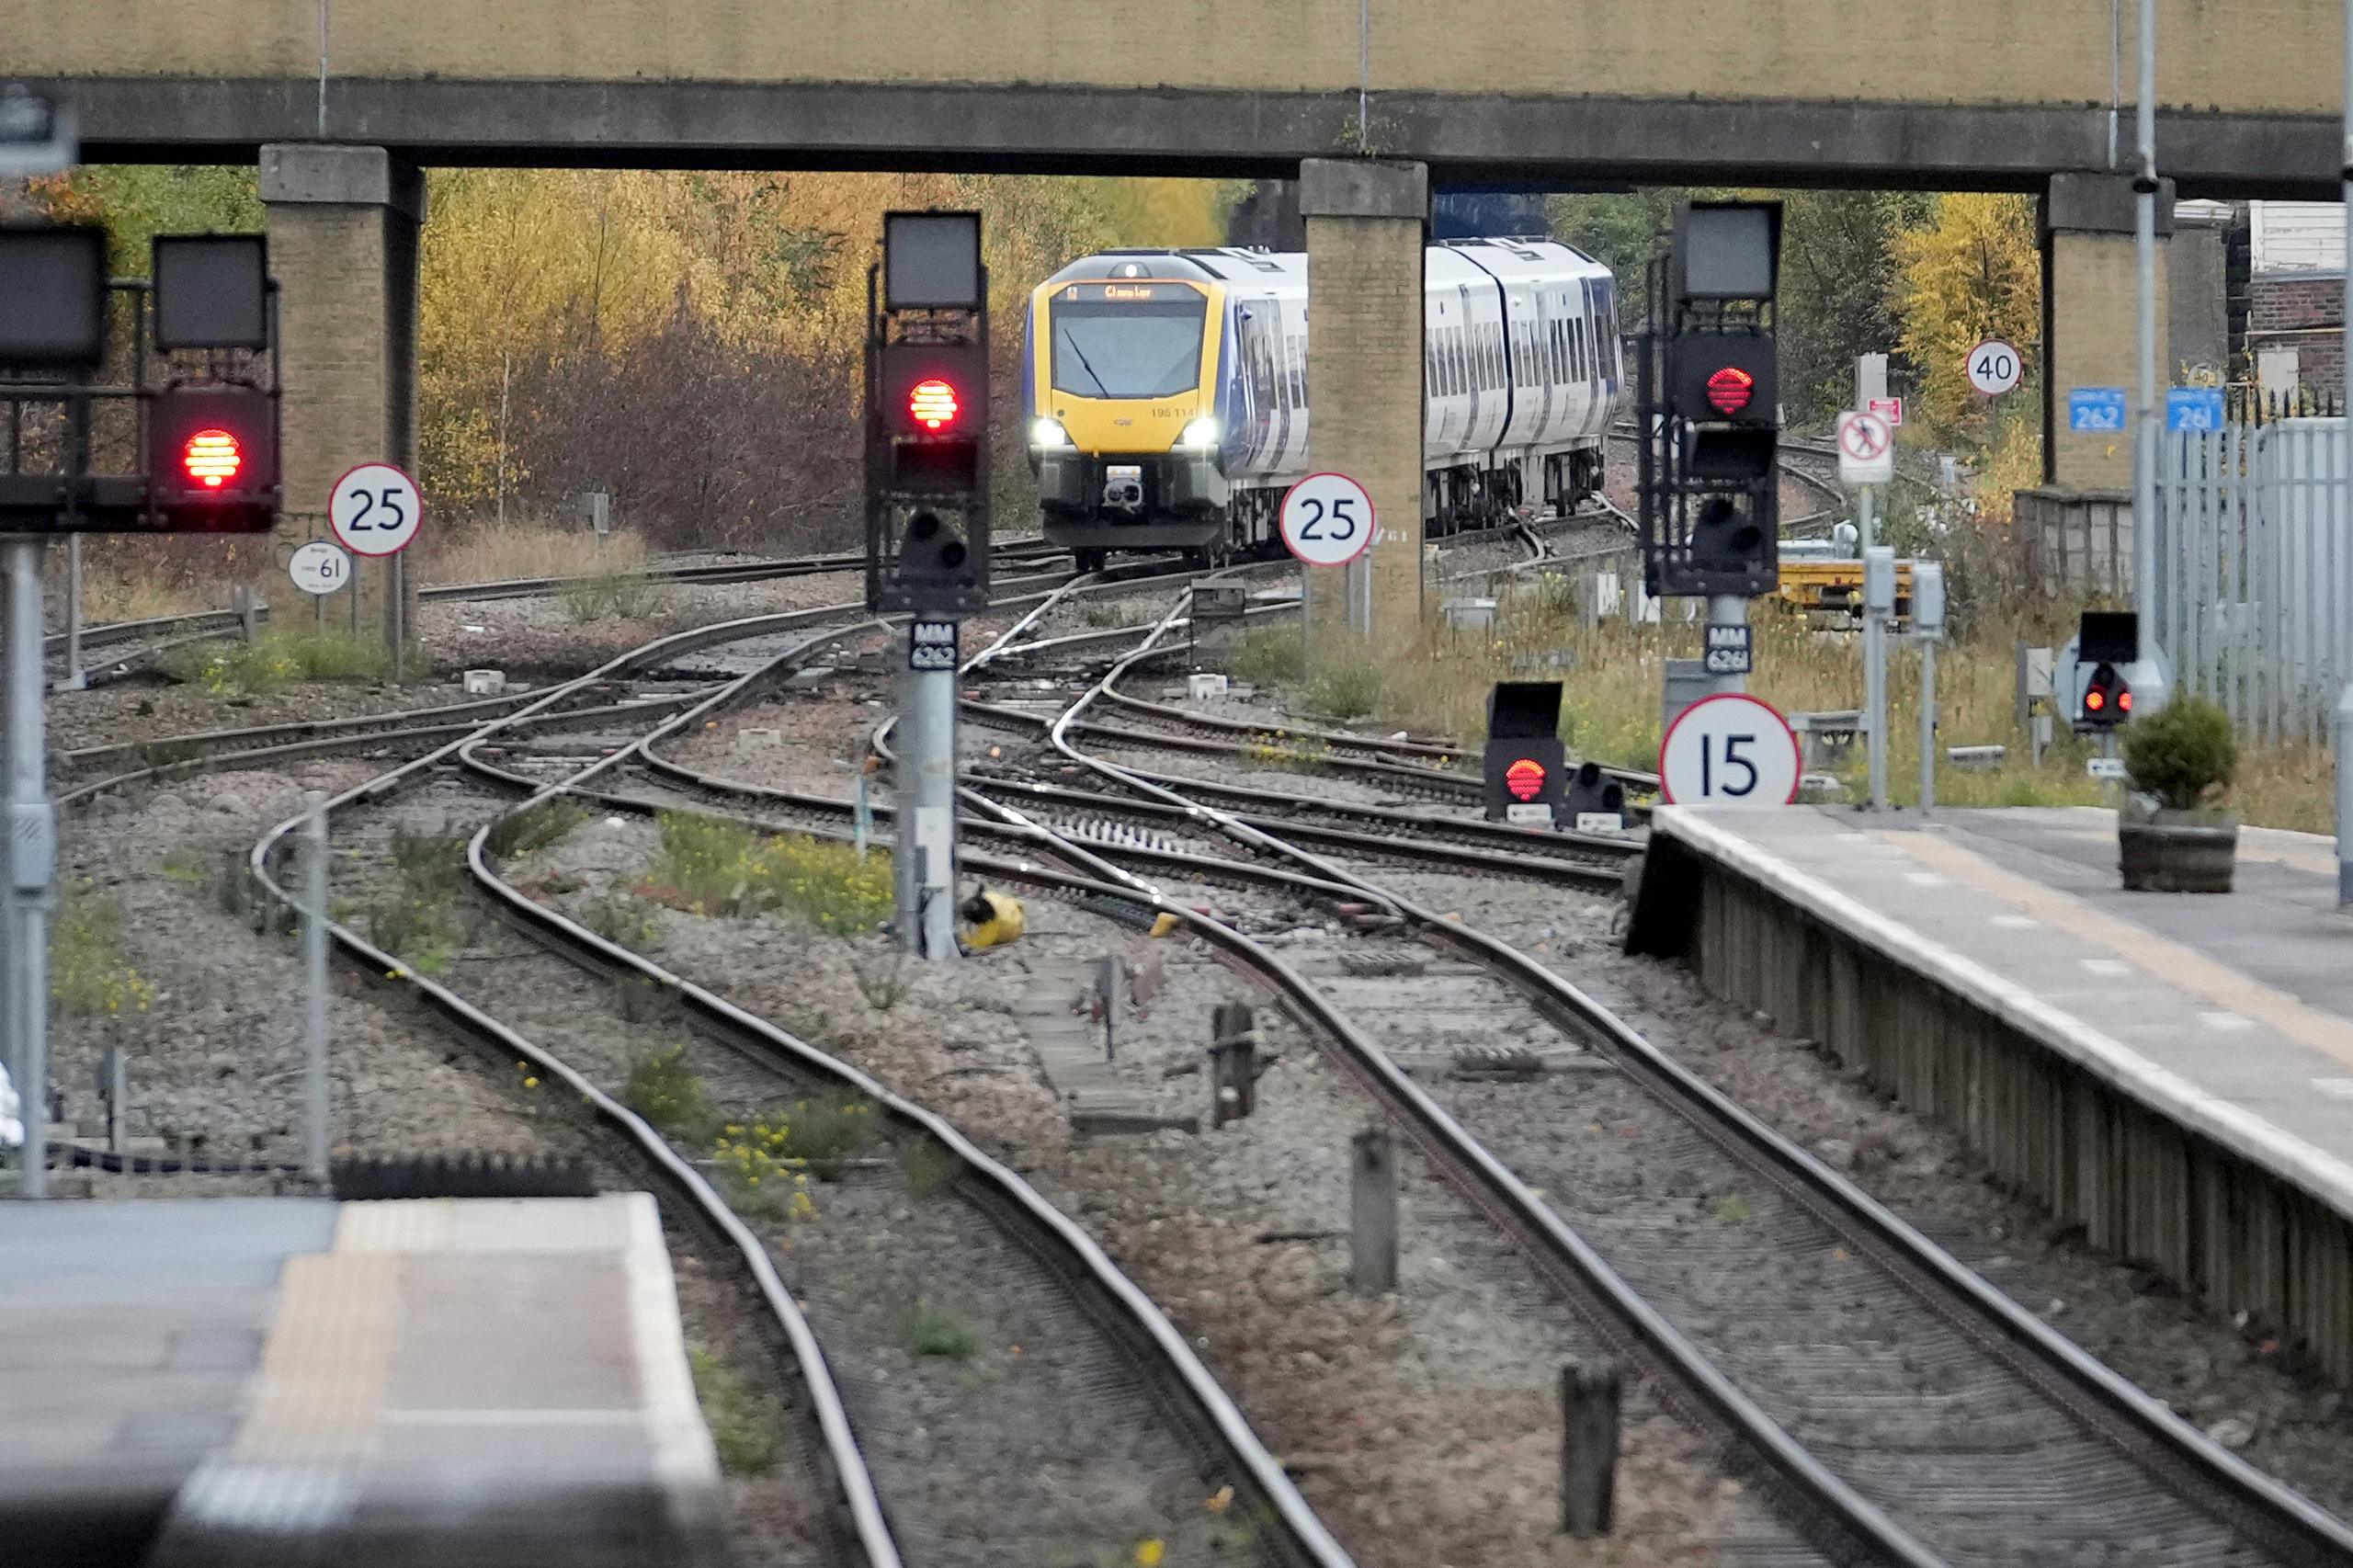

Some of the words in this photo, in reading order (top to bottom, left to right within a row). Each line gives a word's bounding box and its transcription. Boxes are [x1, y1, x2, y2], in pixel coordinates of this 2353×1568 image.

[1976, 355, 2012, 381] 40
[1152, 408, 1171, 418] 195
[2075, 406, 2119, 428] 262
[349, 488, 404, 531] 25
[1300, 498, 1355, 540] 25
[320, 559, 339, 577] 61
[914, 623, 954, 642] MM
[1709, 627, 1747, 645] MM
[912, 646, 956, 668] 6262
[1707, 649, 1749, 672] 6261
[1702, 734, 1758, 797] 15
